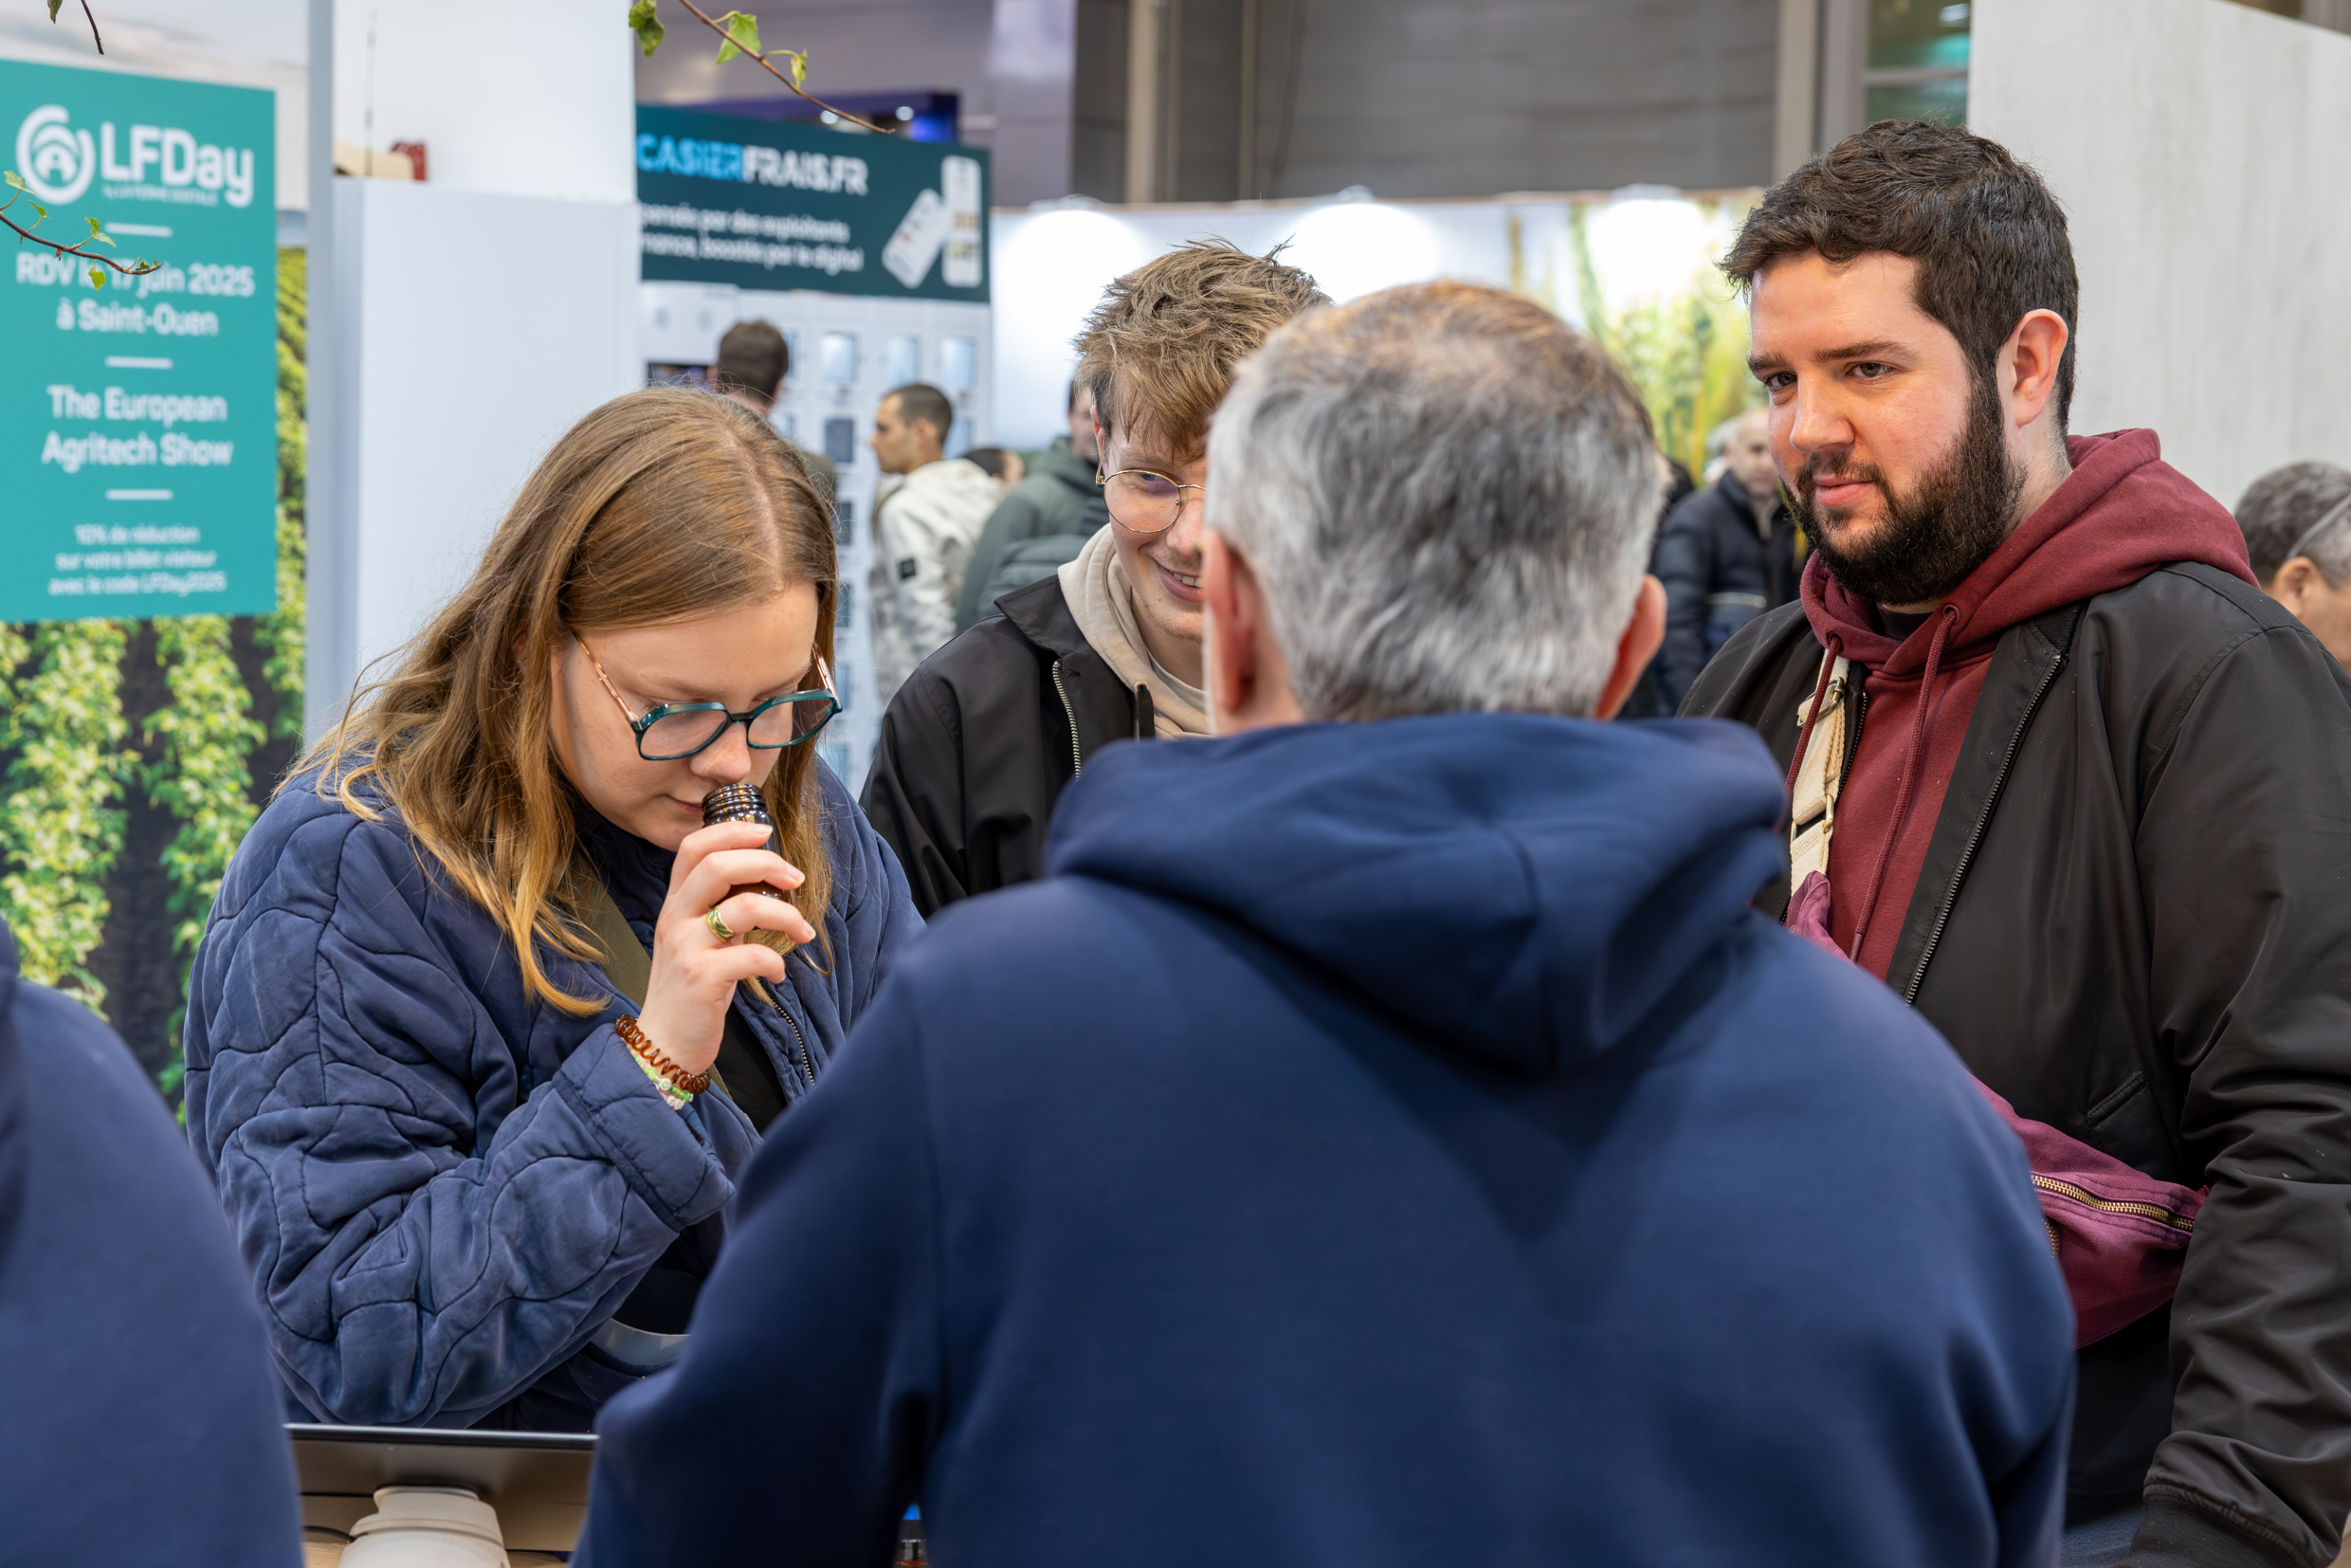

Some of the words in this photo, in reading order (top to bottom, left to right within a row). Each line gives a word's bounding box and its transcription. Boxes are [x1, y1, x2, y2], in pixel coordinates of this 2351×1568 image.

[100, 120, 254, 209] LFDay
[698, 208, 728, 239] par
[729, 207, 760, 236] des
[761, 212, 850, 245] exploitants
[16, 251, 76, 286] RDV
[106, 257, 137, 290] 17
[136, 261, 186, 299] juin
[187, 262, 255, 297] 2025
[700, 233, 764, 264] boostés
[764, 242, 794, 271] par
[795, 242, 812, 269] le
[812, 243, 865, 277] digital
[56, 296, 75, 330] à
[78, 298, 219, 337] Saint-Ouen
[46, 383, 101, 420] The
[104, 386, 228, 429] European
[41, 430, 158, 473] Agritech
[160, 431, 234, 466] Show
[108, 522, 129, 545] de
[130, 522, 201, 545] réduction
[55, 553, 81, 571] sur
[82, 552, 122, 571] votre
[122, 548, 162, 569] billet
[164, 547, 218, 569] visiteur
[48, 577, 85, 596] avec
[86, 573, 102, 595] le
[102, 573, 140, 595] code
